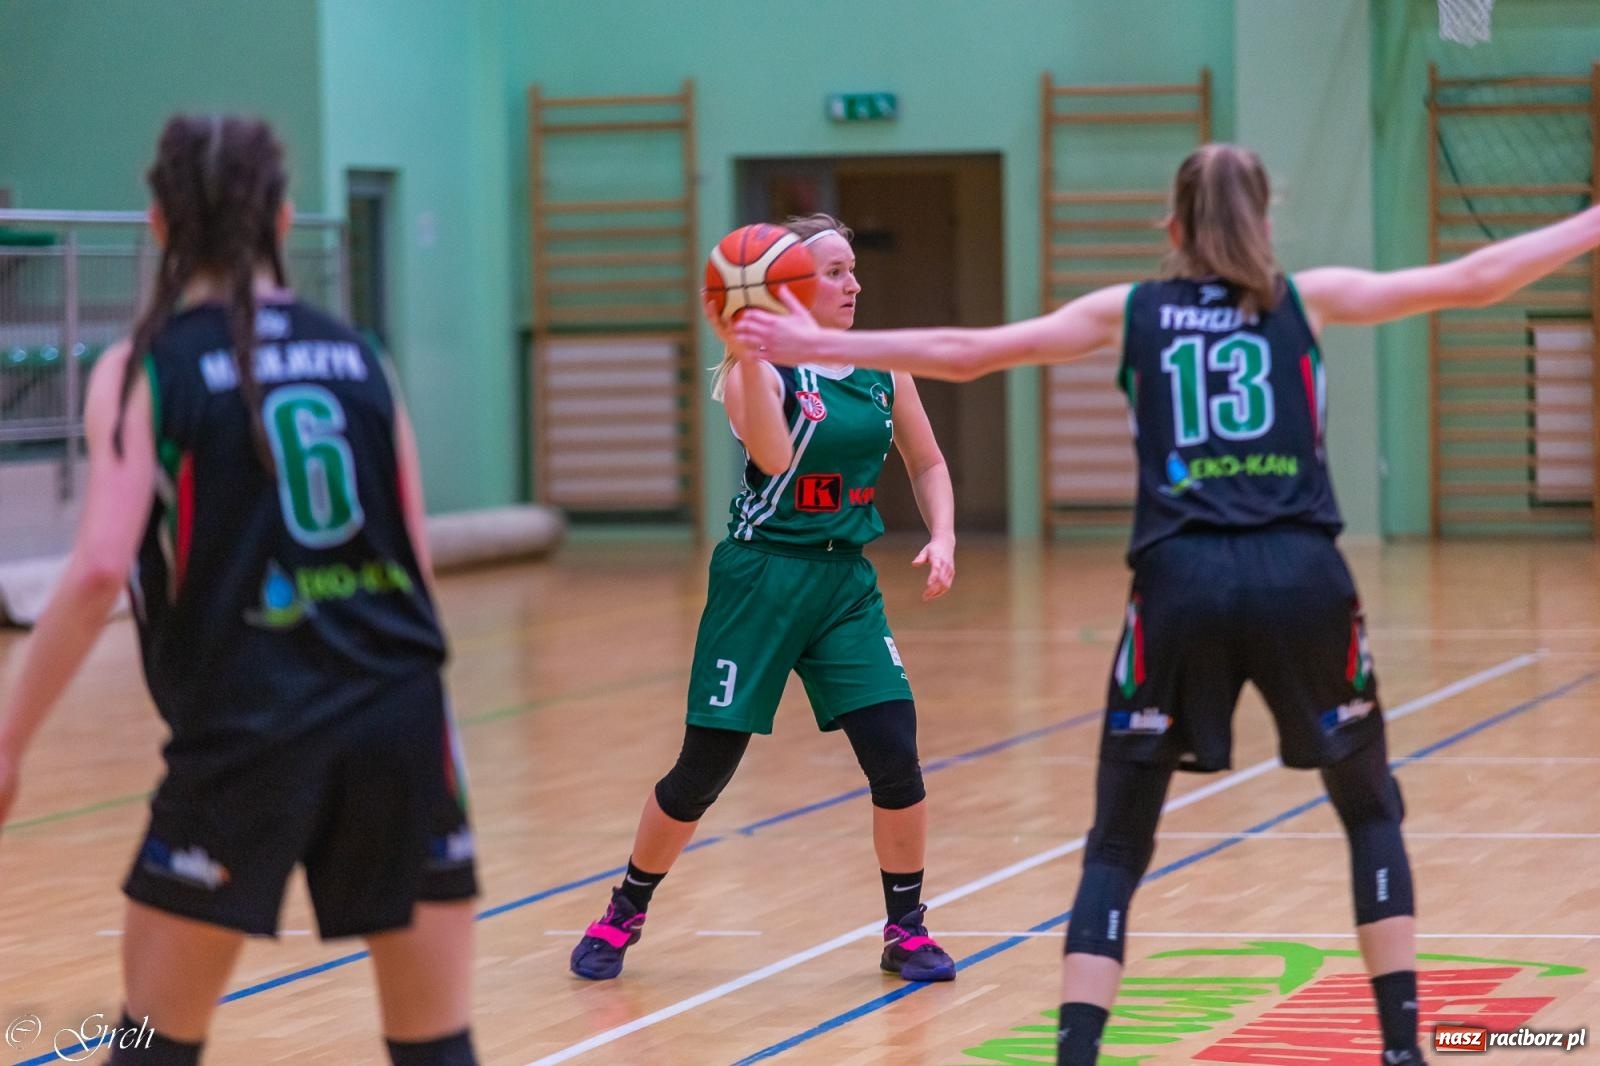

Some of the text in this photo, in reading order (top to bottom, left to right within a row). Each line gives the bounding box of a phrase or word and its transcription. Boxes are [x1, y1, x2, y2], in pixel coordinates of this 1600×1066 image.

[1160, 332, 1275, 447] 13
[262, 384, 364, 549] 6
[709, 659, 738, 707] 3
